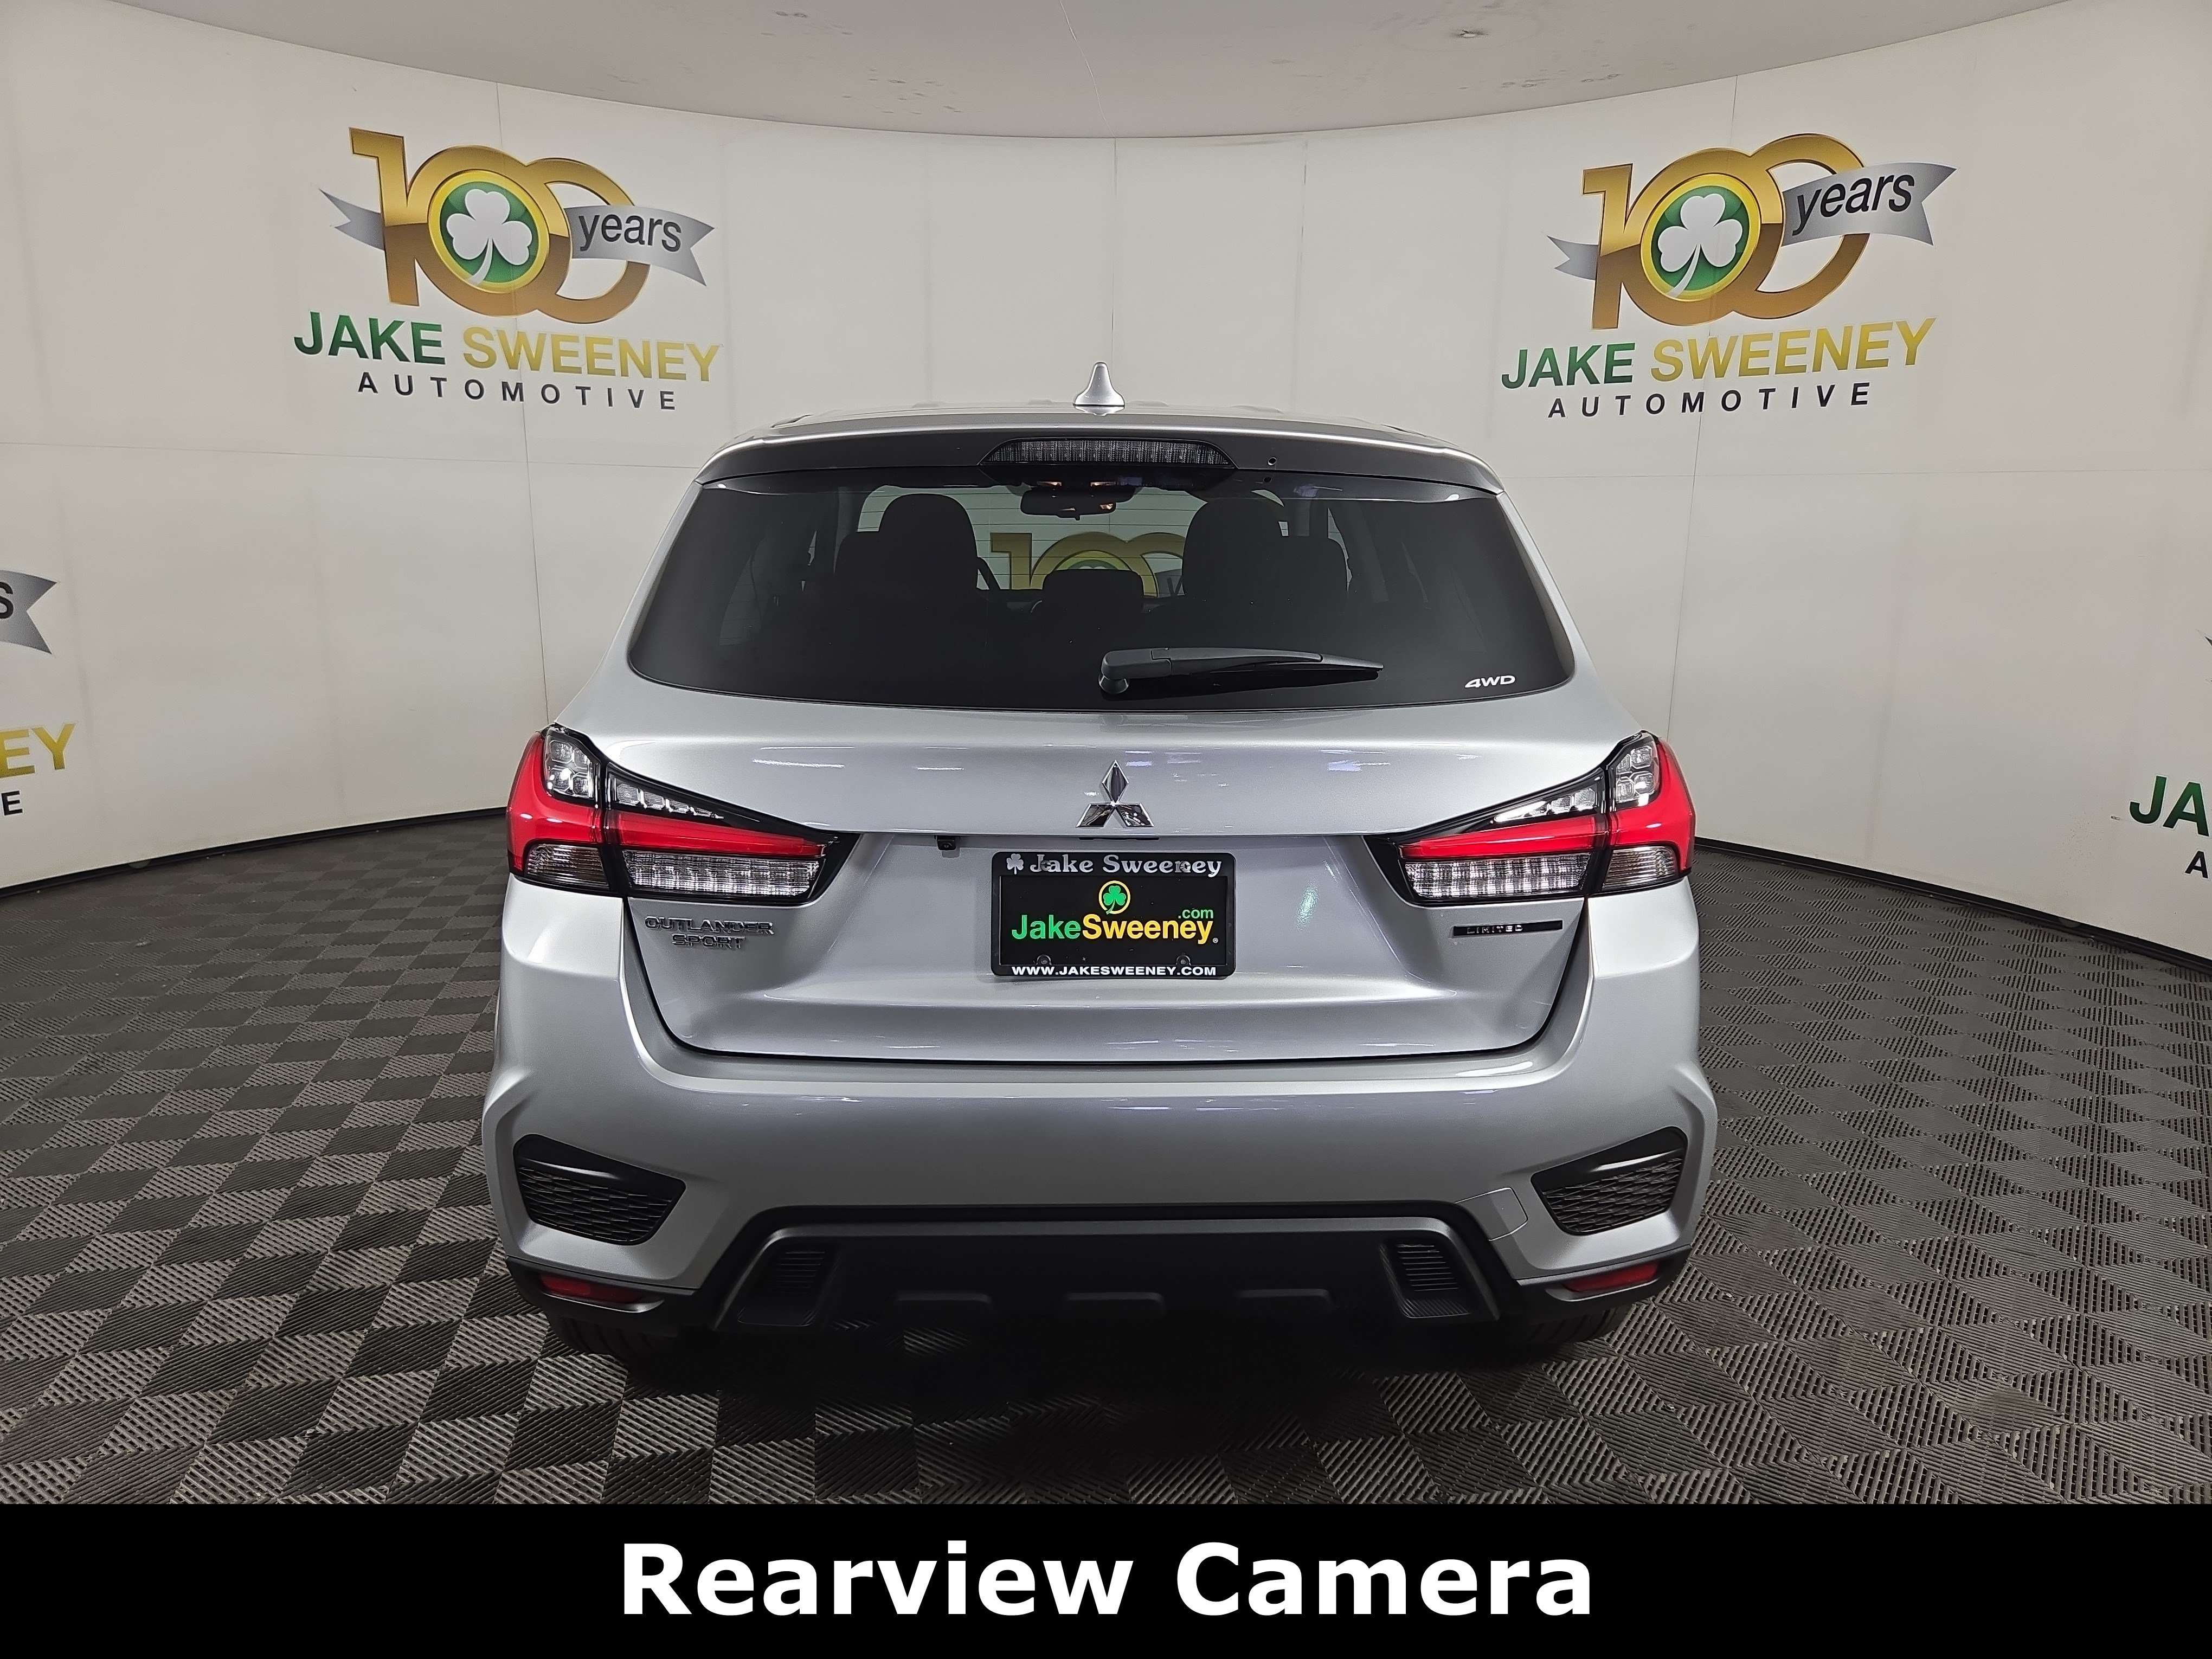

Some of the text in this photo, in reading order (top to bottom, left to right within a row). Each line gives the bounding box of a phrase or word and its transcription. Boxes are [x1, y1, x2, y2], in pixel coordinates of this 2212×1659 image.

[1791, 173, 1916, 236] years
[349, 127, 651, 324] 100
[577, 213, 682, 253] years
[1581, 133, 1872, 330] 100
[294, 311, 723, 382] JAKE SWEENEY
[1501, 318, 1936, 389] JAKE SWEENEY
[358, 372, 676, 410] AUTOMOTIVE
[1548, 382, 1870, 418] AUTOMOTIVE
[1464, 675, 1516, 688] 4WD
[1030, 854, 1222, 878] Jake Sweeney
[645, 916, 774, 935] OUTLANDER
[1178, 908, 1214, 919] .com
[1467, 925, 1523, 934] LIMITED
[672, 934, 745, 949] SPORT
[1012, 966, 1217, 976] WWW.JAKESWEENEY.COM
